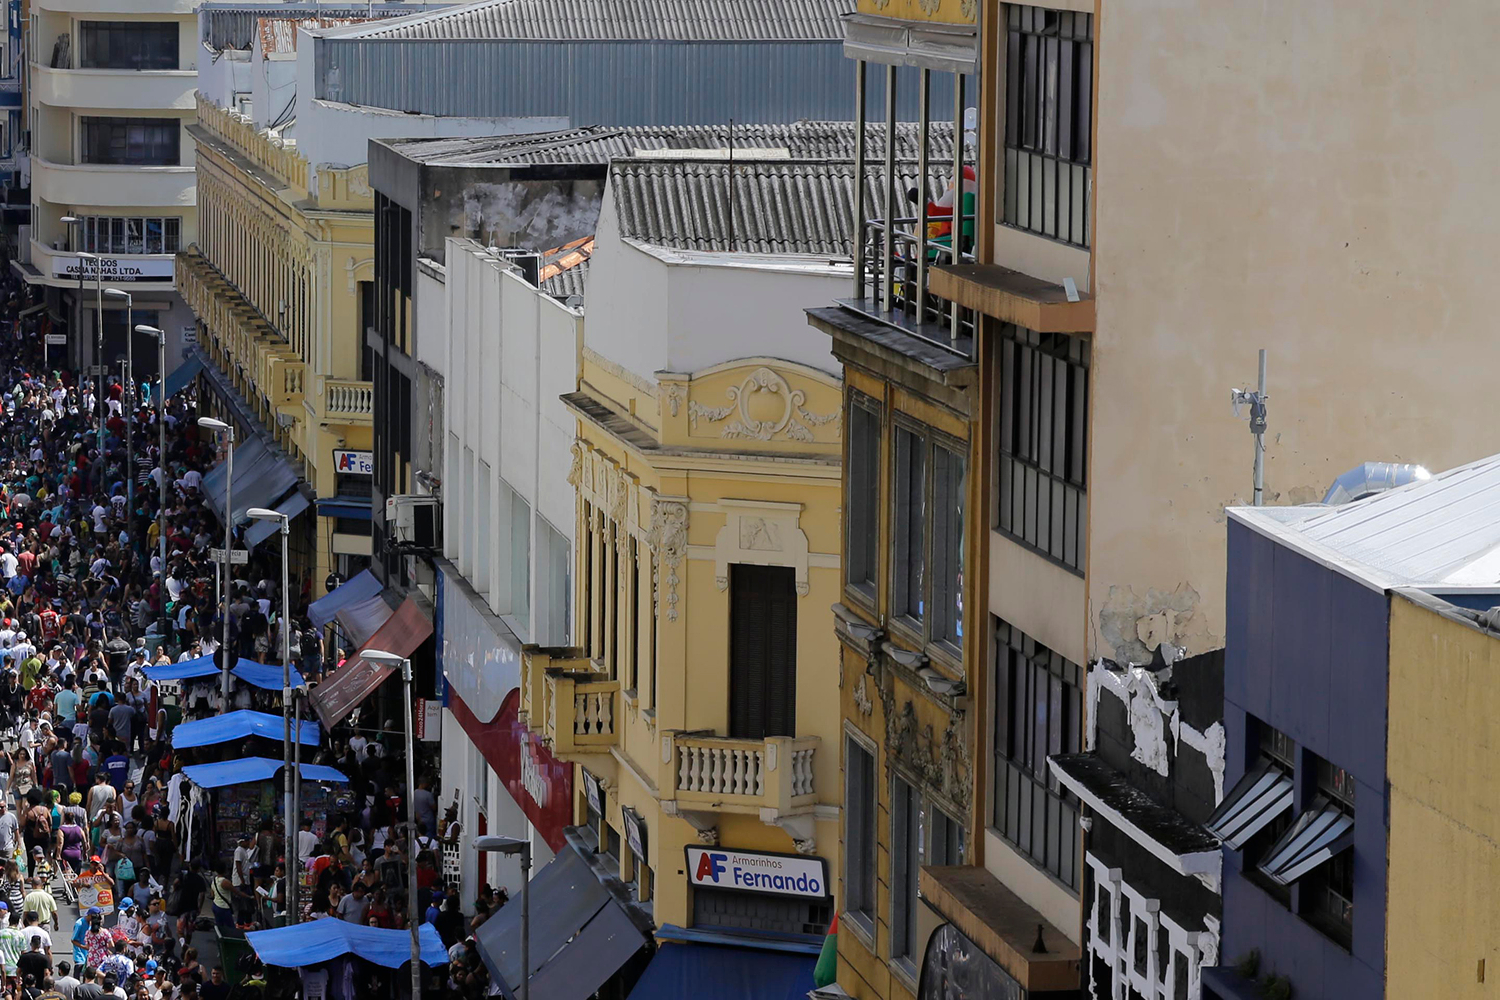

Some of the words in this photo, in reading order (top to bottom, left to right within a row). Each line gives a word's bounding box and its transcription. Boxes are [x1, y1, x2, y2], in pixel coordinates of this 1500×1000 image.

[339, 453, 357, 471] AF
[696, 852, 728, 883] AF
[732, 855, 782, 869] Armarinhos
[733, 867, 820, 893] Fernando
